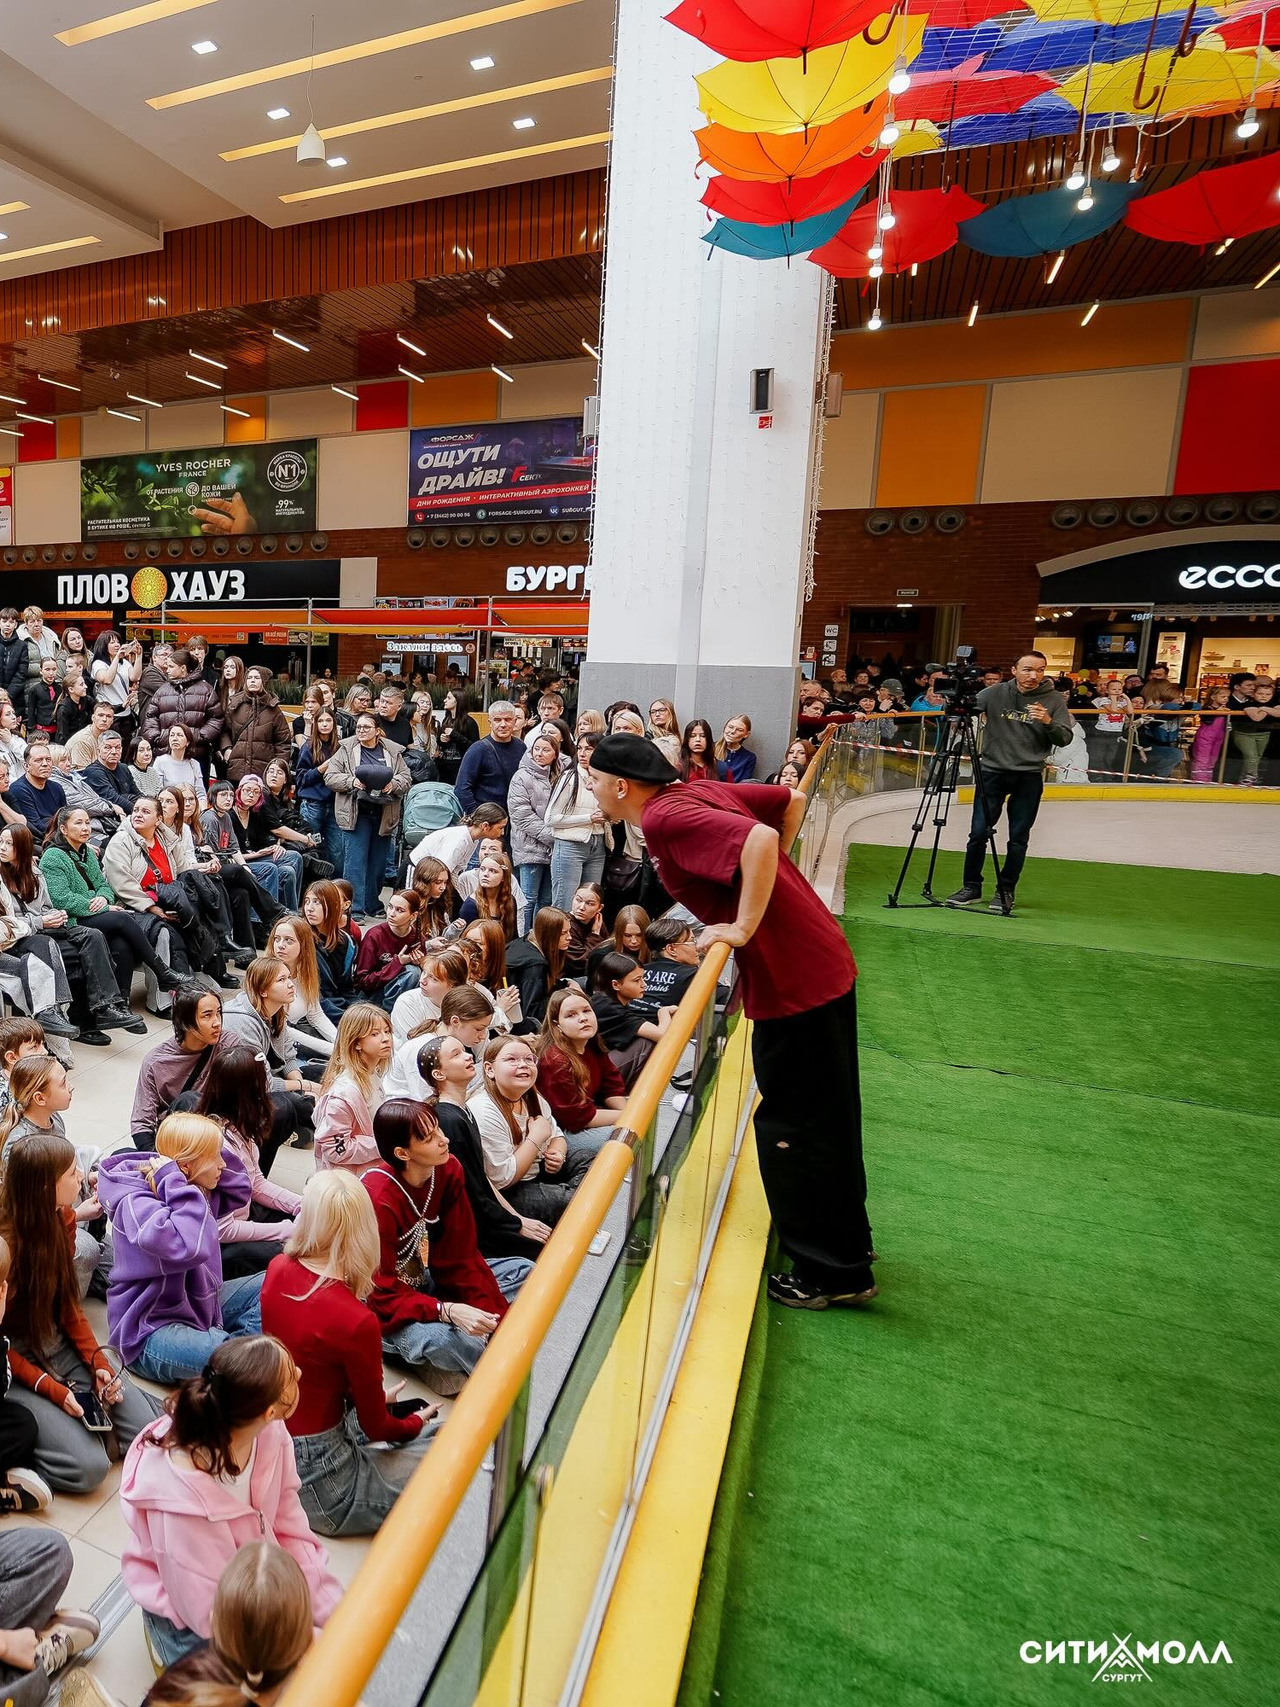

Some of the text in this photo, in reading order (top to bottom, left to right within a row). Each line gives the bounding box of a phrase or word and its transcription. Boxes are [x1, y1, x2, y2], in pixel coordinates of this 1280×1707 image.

[431, 434, 474, 443] ФОРСАЖ
[417, 444, 501, 469] ОЩУТИ
[156, 458, 231, 472] YVES ROCHER
[178, 470, 207, 478] FRANCE
[417, 466, 506, 495] ДРАЙВ!
[153, 487, 183, 495] РАСТЕНИЯ
[201, 483, 236, 493] ДО ВАШЕЙ
[432, 496, 471, 505] РОЖДЕНИЯ
[479, 488, 540, 500] ИНТЕРАКТИВНЫЙ
[541, 484, 590, 495] АЭРОХОККЕЙ
[57, 569, 246, 605] ПЛОВ ХАУЗ
